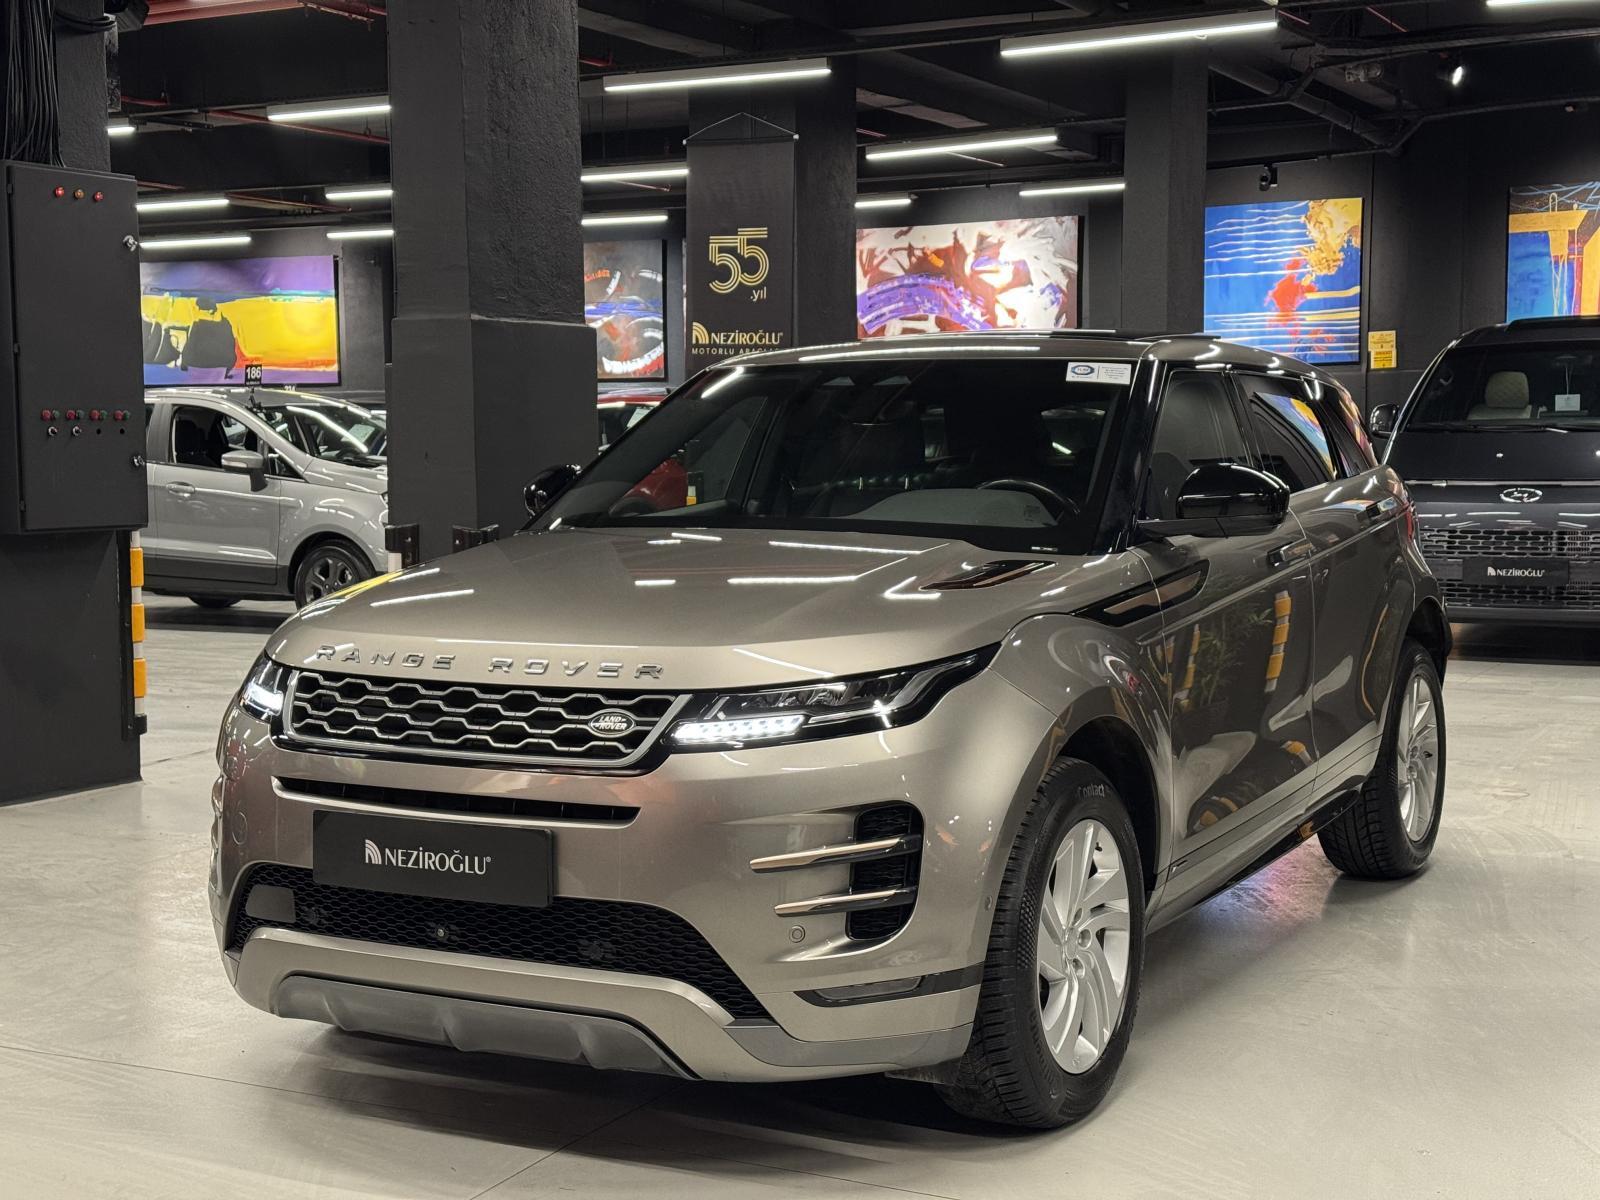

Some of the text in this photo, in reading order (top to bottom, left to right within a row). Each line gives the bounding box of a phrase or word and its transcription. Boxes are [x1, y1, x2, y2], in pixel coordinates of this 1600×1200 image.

[709, 227, 770, 294] 55
[691, 347, 735, 355] MOTORLU
[246, 366, 262, 379] 186
[316, 645, 664, 679] RANGE ROVER
